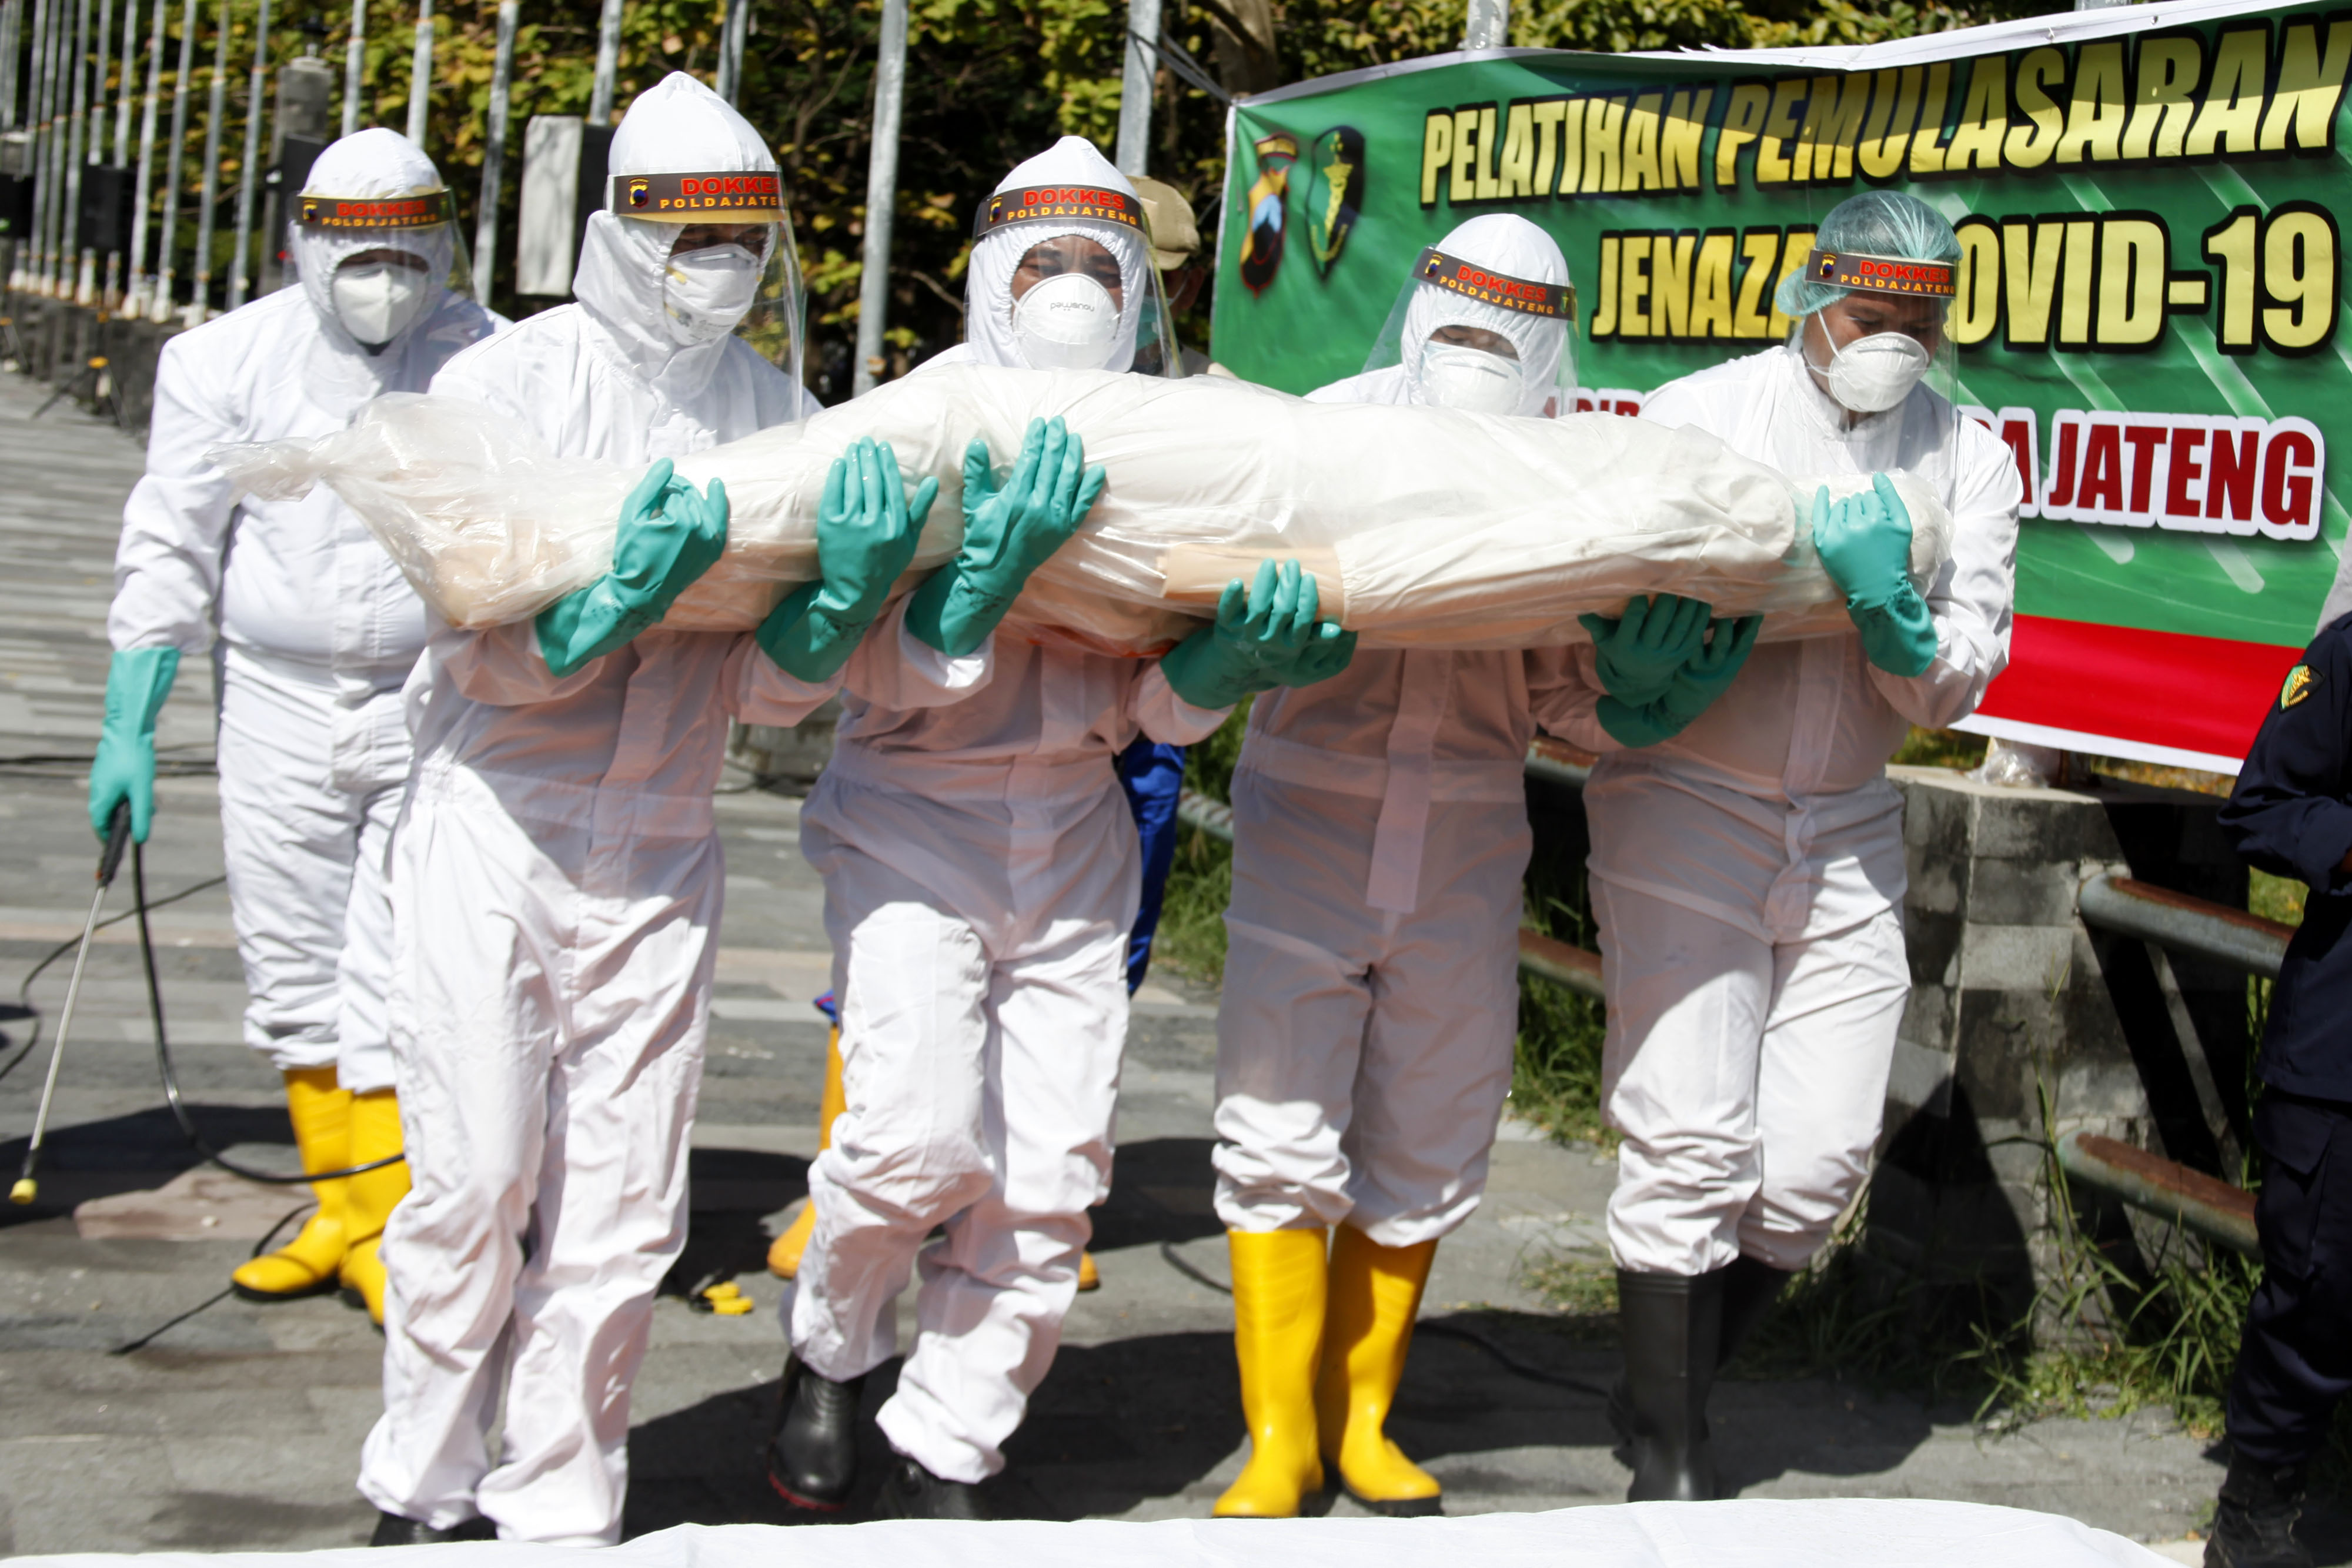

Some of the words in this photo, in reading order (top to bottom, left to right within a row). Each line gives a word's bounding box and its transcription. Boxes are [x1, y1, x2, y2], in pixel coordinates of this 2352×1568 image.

[1420, 87, 1715, 206] PELATIHAN
[1716, 19, 2352, 187] PEMULASARAN
[336, 200, 426, 217] DOKKES
[659, 196, 788, 209] POLDAJATE
[1023, 188, 1125, 210] DOKKES
[1007, 206, 1137, 226] POLDAJATENG
[1456, 265, 1547, 302] DOKKES
[1859, 260, 1950, 283] DOKKES
[1943, 210, 2335, 348] OVID-19
[1439, 275, 1555, 315] POLDAJATENG
[2049, 421, 2316, 526] JATENG
